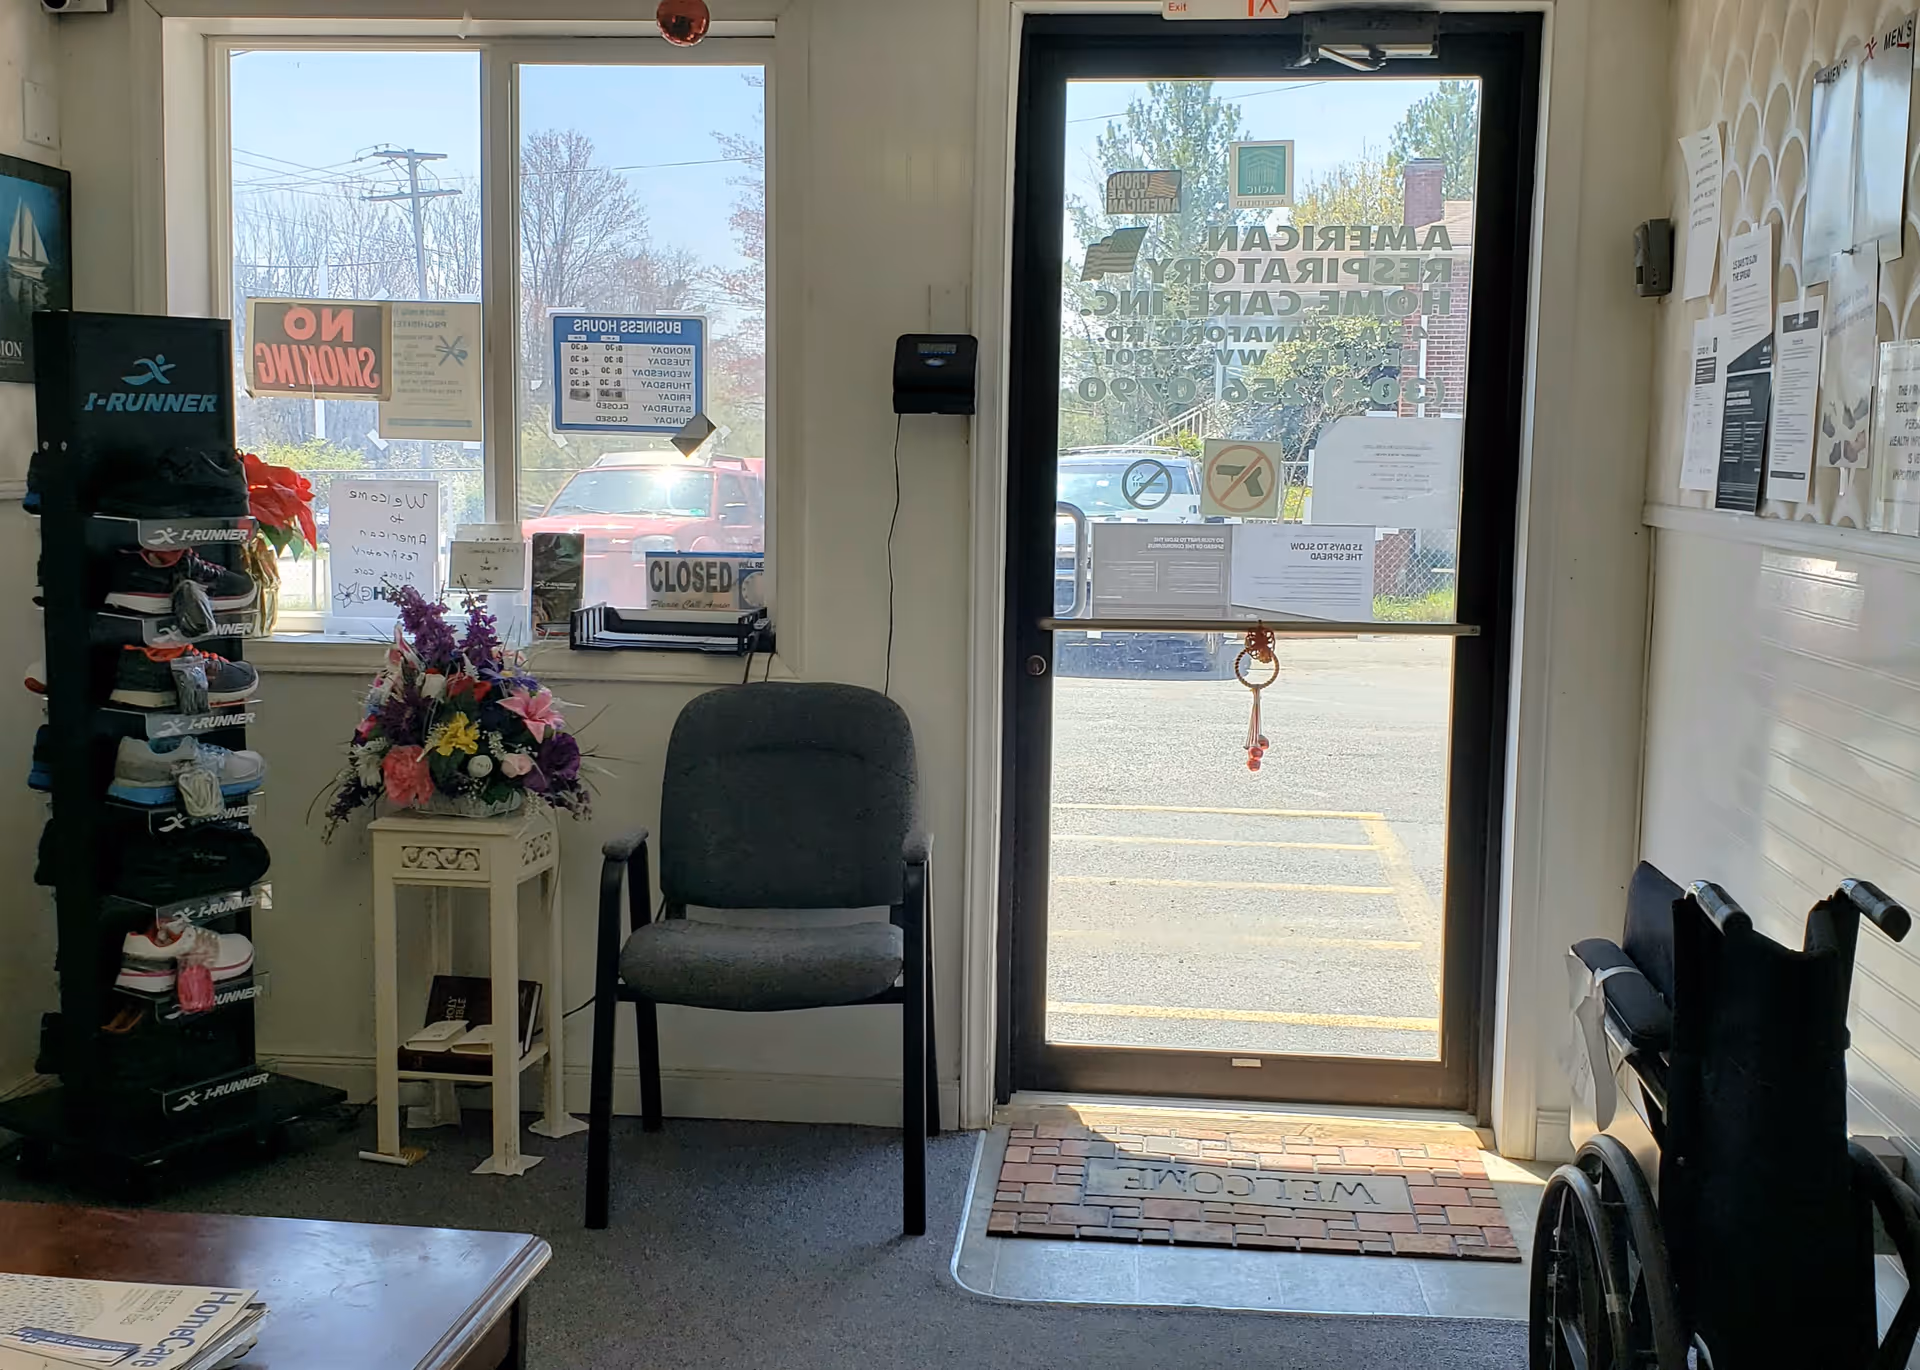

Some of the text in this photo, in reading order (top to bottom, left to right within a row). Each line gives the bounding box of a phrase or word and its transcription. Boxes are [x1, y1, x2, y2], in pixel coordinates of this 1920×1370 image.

[1167, 2, 1187, 12] Exit
[1883, 19, 1912, 51] MEN'S
[0, 340, 23, 357] ION
[83, 392, 218, 413] I-RUNNER
[180, 529, 249, 541] I-RUNNER
[651, 560, 732, 593] CLOSED
[188, 712, 256, 730] I-RUNNER
[455, 997, 466, 1020] IBLE
[202, 1073, 270, 1101] I-RUNNER
[1123, 1167, 1381, 1206] WELCOME
[131, 1291, 243, 1369] HomeCare
